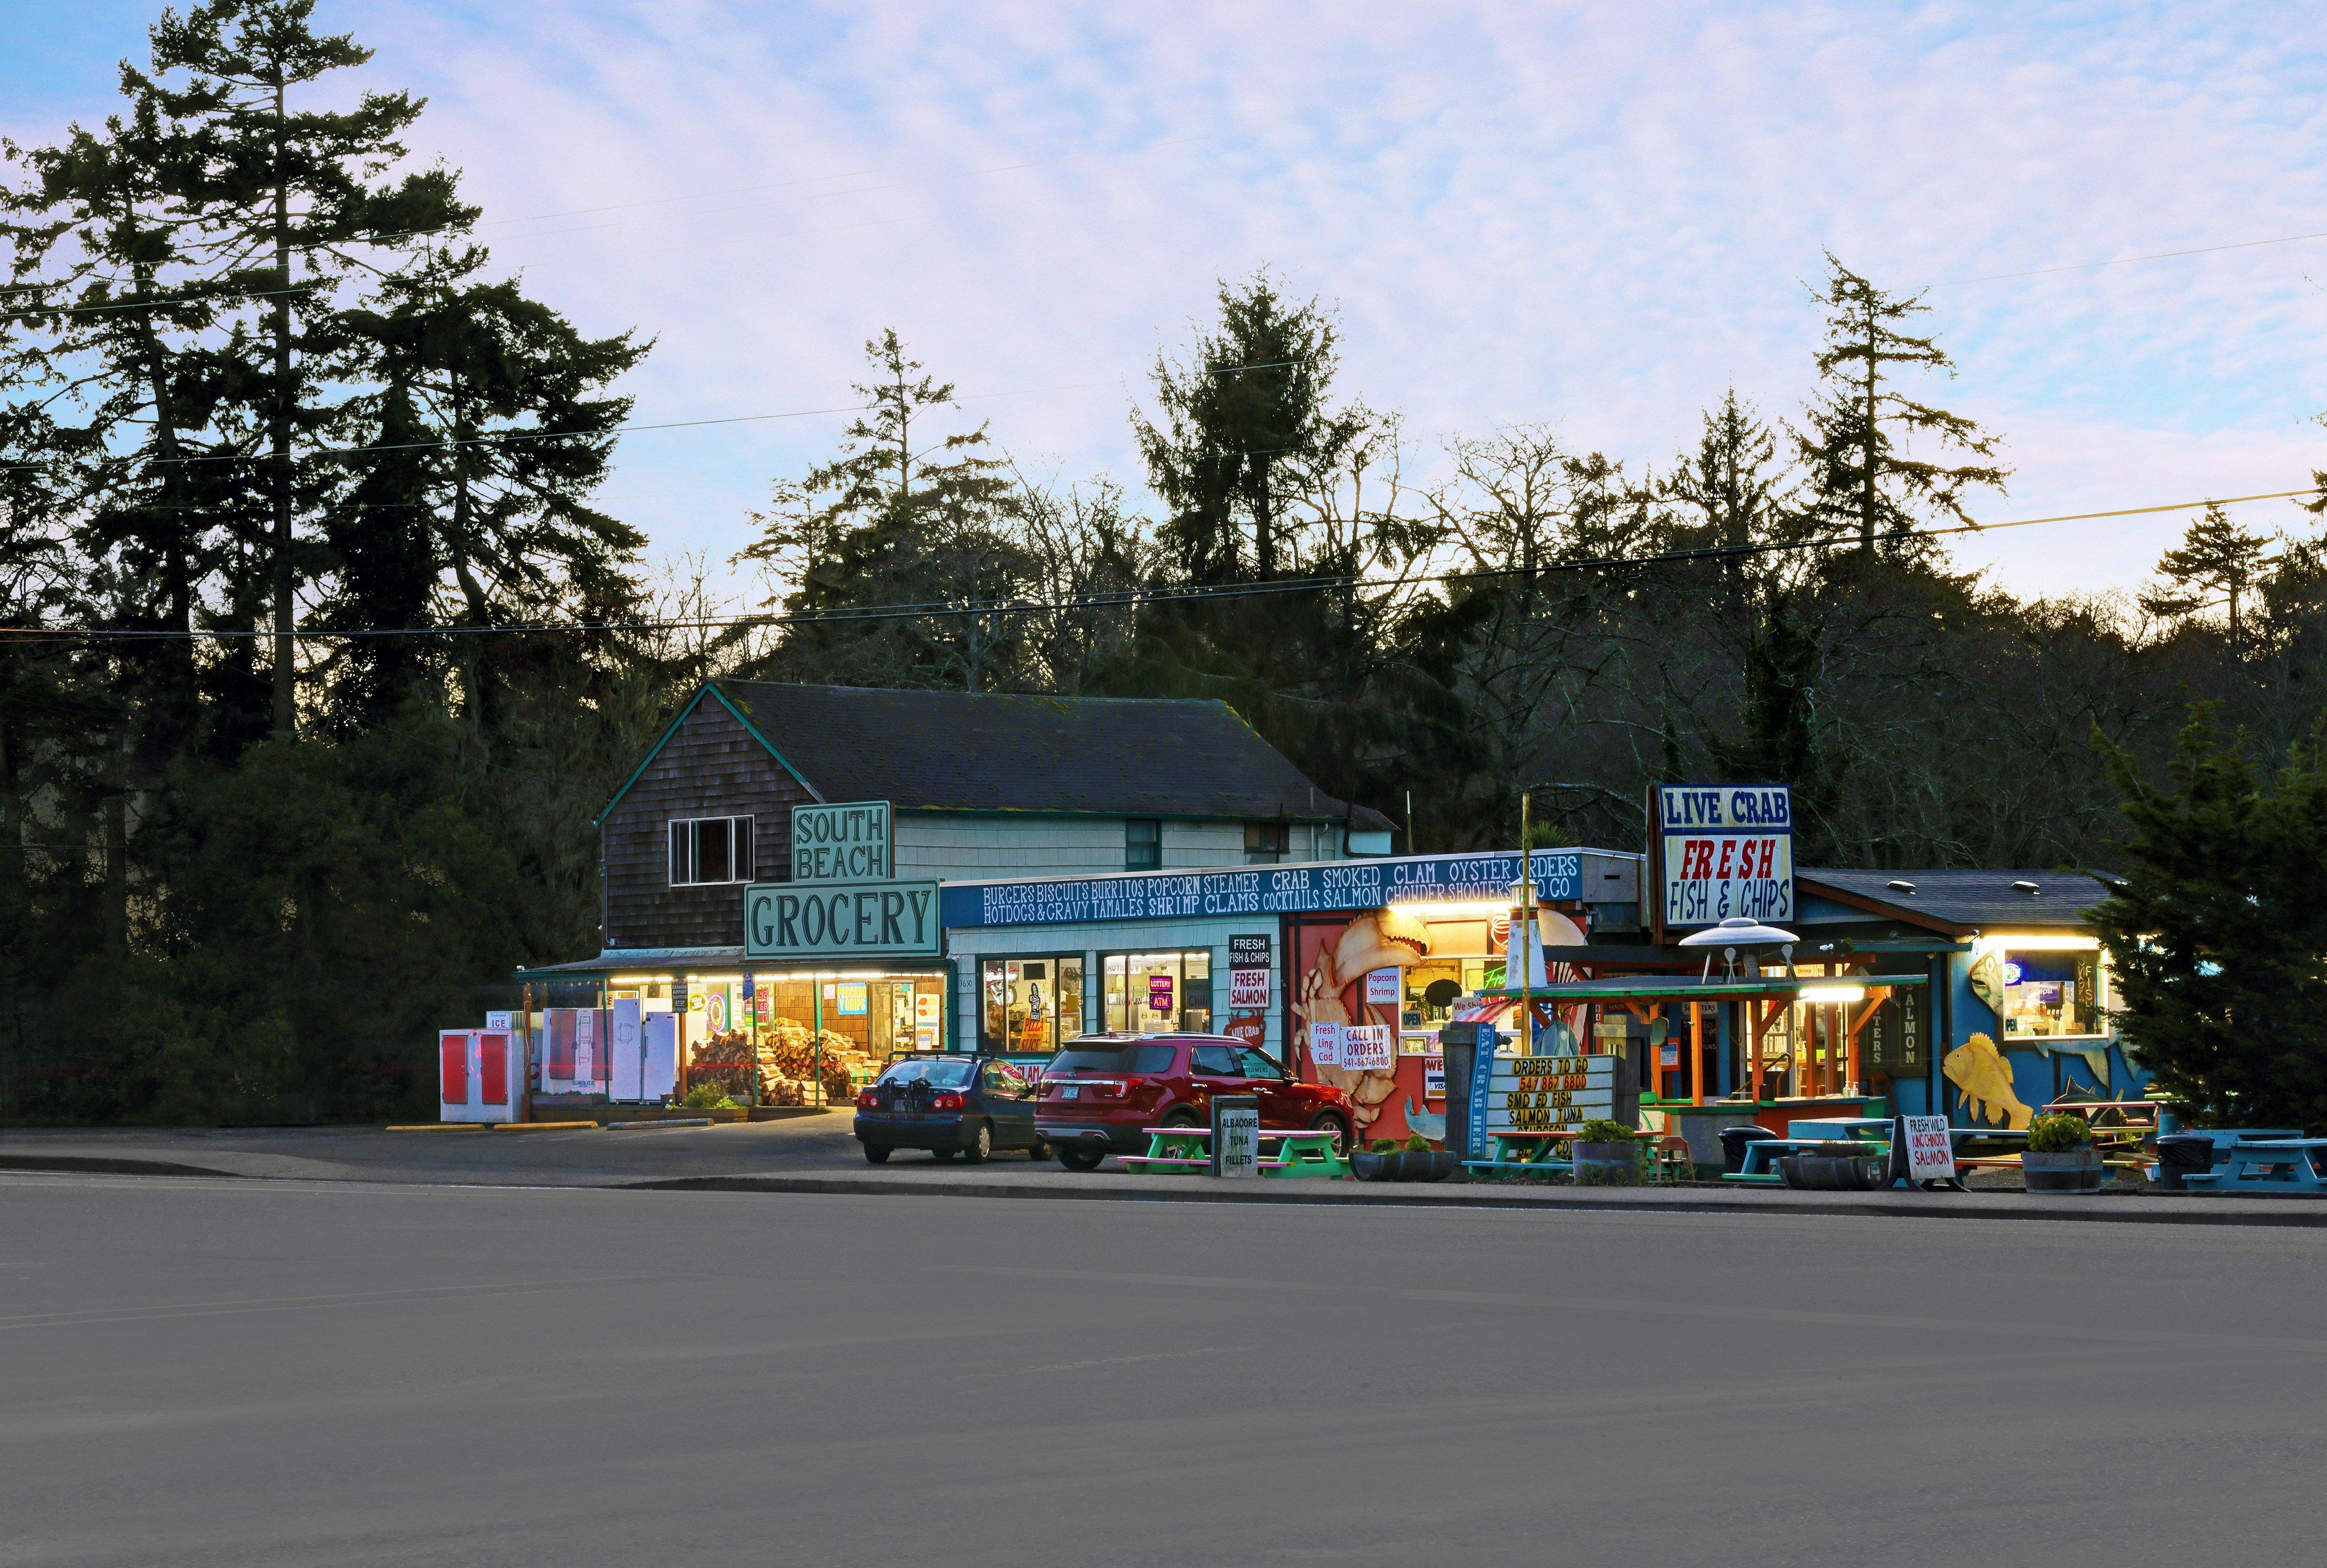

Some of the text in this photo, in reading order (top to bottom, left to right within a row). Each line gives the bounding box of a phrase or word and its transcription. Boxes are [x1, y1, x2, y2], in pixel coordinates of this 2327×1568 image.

[1665, 791, 1788, 823] LIVE CRAB
[796, 808, 883, 844] SOUTH
[795, 844, 883, 879] BEACH
[1680, 839, 1776, 880] FRESH
[983, 855, 1577, 905] BURGERS BISCUITS BURRITOS POPCORN STEAMER CRAB SMOKED CLAM OYSTER ORDERS
[983, 903, 1035, 924] HOTDOGS
[1037, 904, 1045, 921] &
[1046, 901, 1090, 920] GRAVY
[1092, 898, 1144, 919] TAMALES
[1148, 895, 1200, 916] SHRIMP
[1204, 892, 1259, 914] CLAMS
[1263, 889, 1319, 910] COCKTAILS
[1323, 886, 1381, 908] SALMON
[1385, 882, 1445, 905] CHOWDER
[1448, 881, 1511, 901] SHOOTERS
[1549, 878, 1570, 899] GO
[1669, 879, 1789, 920] FISH & CHIPS
[751, 890, 931, 947] GROCERY
[1234, 939, 1265, 950] FRESH
[1229, 952, 1270, 963] FISH & CHIPS
[1150, 980, 1171, 988] LOTTERY
[1234, 972, 1265, 986] FRESH
[1368, 974, 1396, 983] Popcorn
[1231, 989, 1267, 1005] SALMON
[1370, 987, 1395, 997] Shrimp
[2039, 987, 2053, 995] epsi
[1153, 996, 1168, 1007] ATM
[1188, 995, 1208, 1007] Chili
[1453, 1002, 1466, 1010] We
[492, 1019, 505, 1027] ICE
[1024, 1017, 1043, 1032] PIZZA
[1403, 1013, 1421, 1026] OPEN
[2005, 1019, 2017, 1031] PEN
[1231, 1026, 1260, 1039] LIVE CRAB
[1316, 1025, 1335, 1034] Fresh
[1346, 1029, 1383, 1042] CALL IN
[1020, 1038, 1041, 1051] SLICE
[1318, 1039, 1333, 1050] Ling
[1347, 1042, 1384, 1056] ORDERS
[1481, 1028, 1490, 1058] EAT
[1318, 1052, 1333, 1061] Cod
[1344, 1057, 1389, 1068] 541-867-6800
[1427, 1060, 1443, 1071] WE
[1514, 1058, 1588, 1075] ORDERS TO GO
[1474, 1065, 1487, 1108] CRAB
[1520, 1074, 1587, 1091] 541 867 6800
[1553, 1092, 1572, 1106] FISH
[1509, 1107, 1583, 1124] SALMON TUNA
[1222, 1118, 1258, 1128] ALBACORE
[1910, 1118, 1945, 1133] FRESH WILD
[1230, 1136, 1248, 1146] TUNA
[1912, 1133, 1947, 1148] KING CHINOOK
[1225, 1155, 1252, 1165] FILLETS
[1914, 1150, 1950, 1166] SALMON
